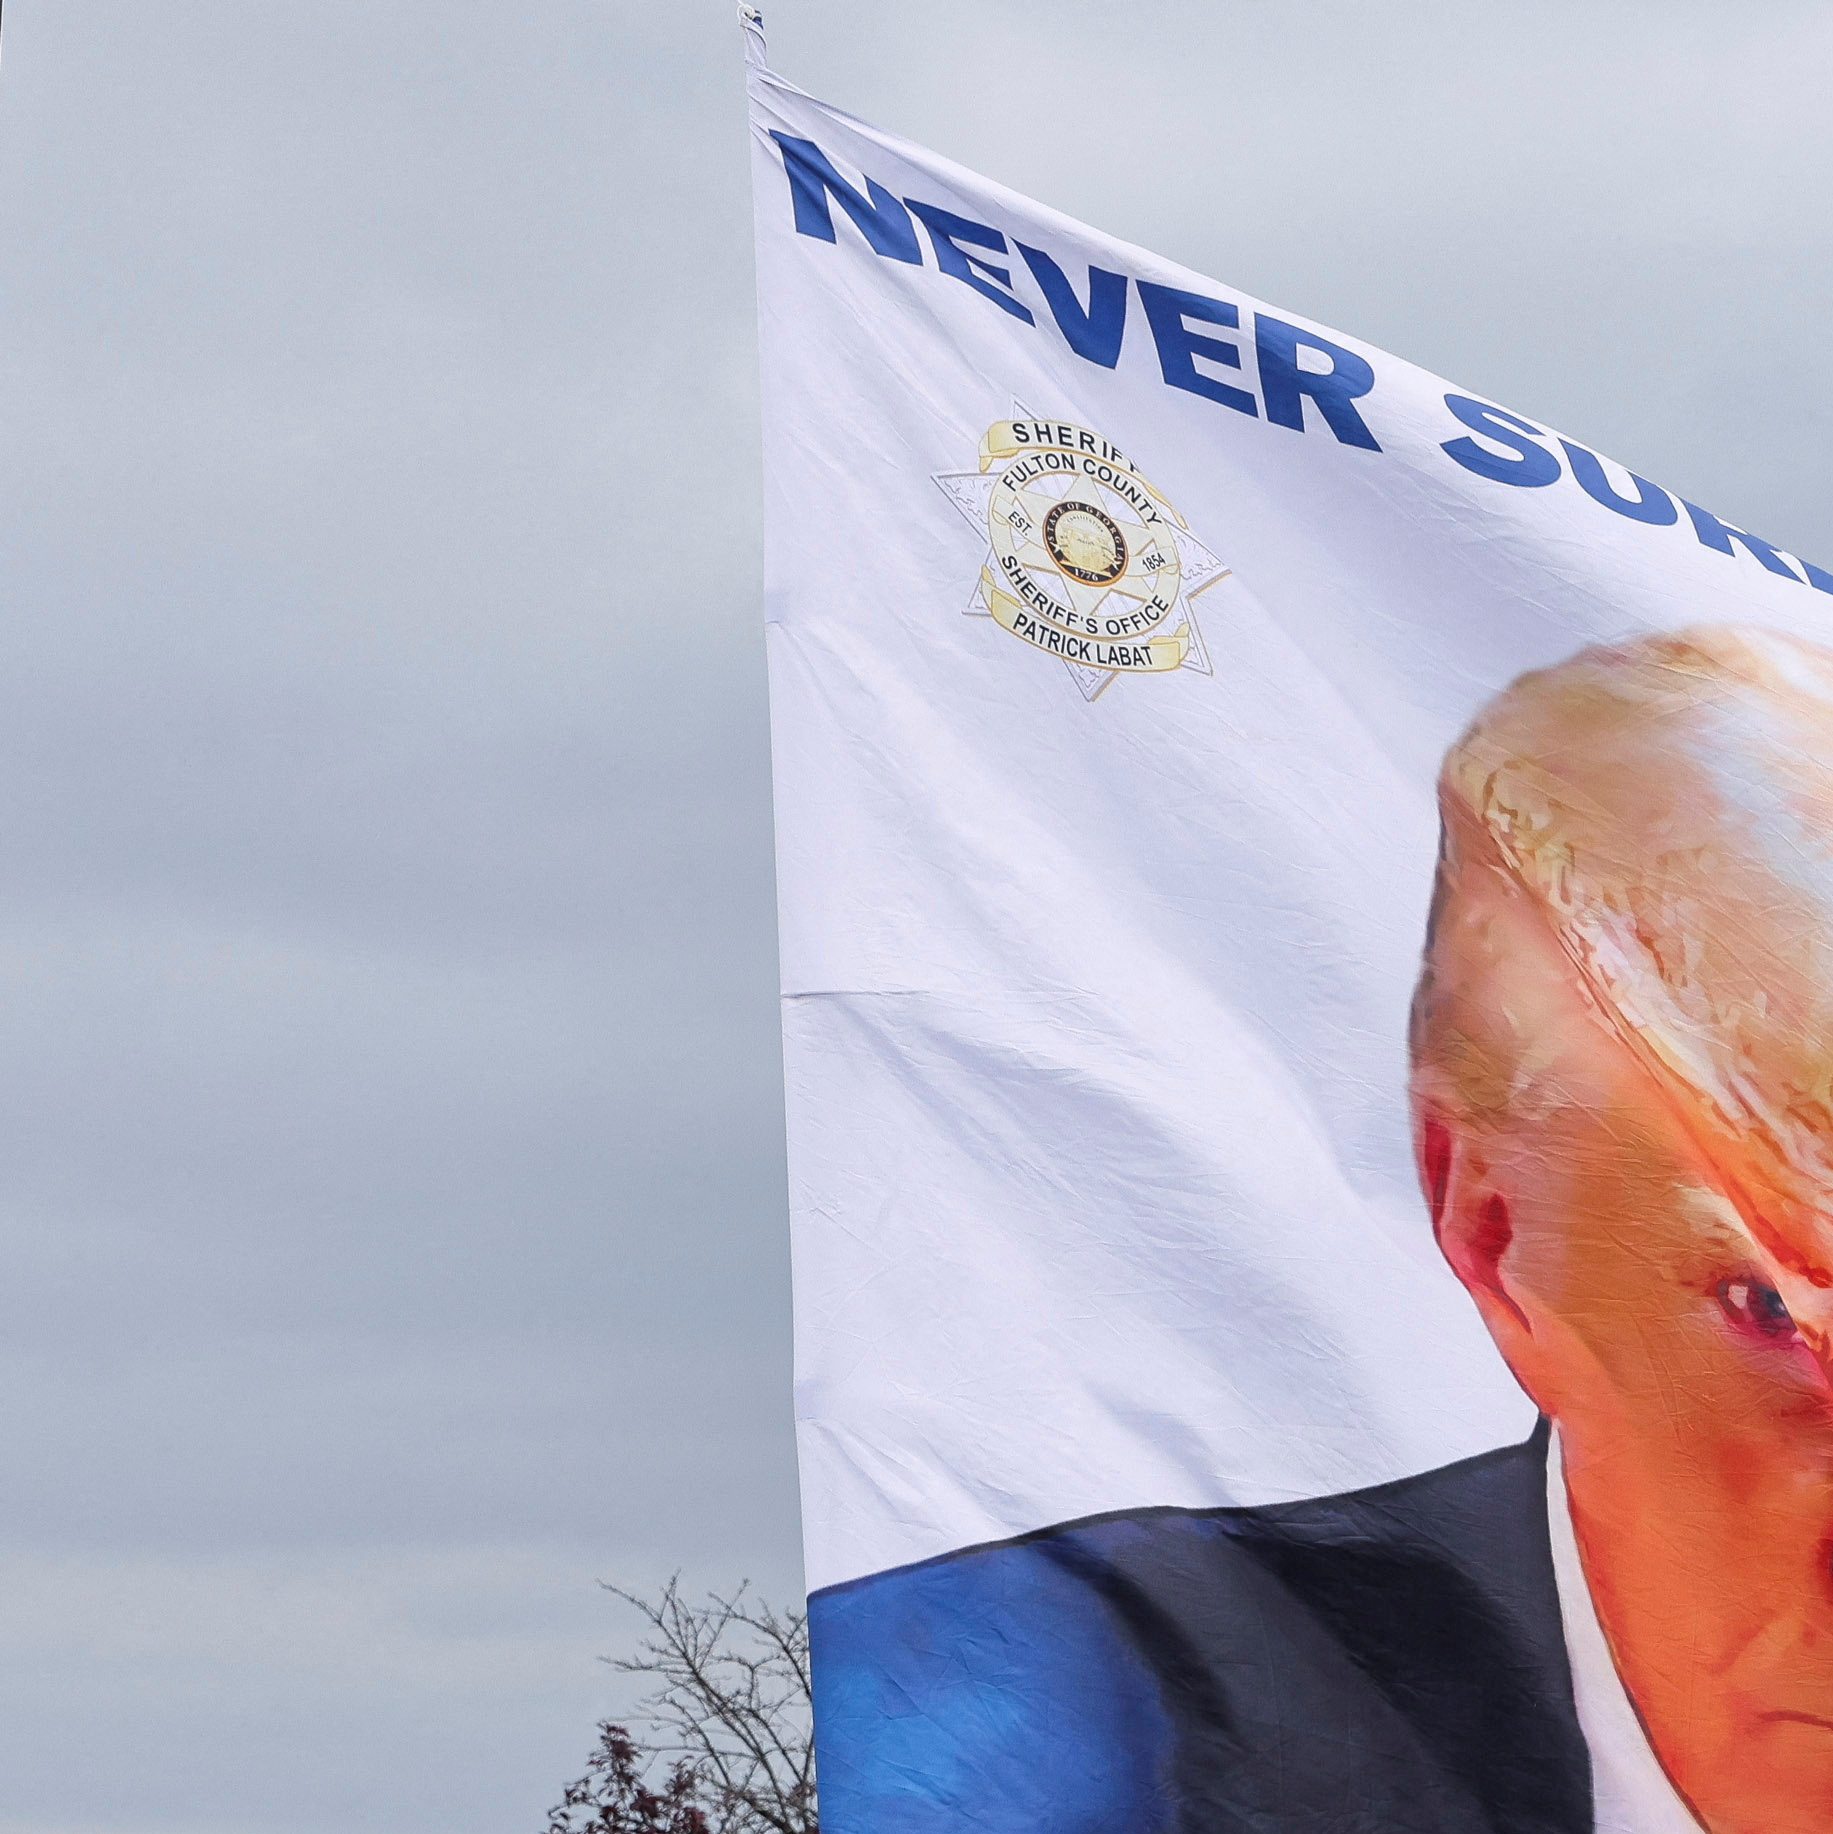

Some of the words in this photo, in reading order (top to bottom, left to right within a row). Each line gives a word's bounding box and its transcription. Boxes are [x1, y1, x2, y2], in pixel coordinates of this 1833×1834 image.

[768, 128, 1382, 453] NEVER
[1003, 452, 1075, 491] FULTON
[1083, 459, 1162, 526] COUNTY
[1008, 511, 1032, 537] EST.
[1047, 505, 1065, 541] STATE
[1067, 502, 1081, 511] OF
[1086, 505, 1124, 560] GEORGIA
[1075, 568, 1098, 581] 1776
[1142, 552, 1165, 572] 1854
[1002, 555, 1098, 635] SHERIFF'S
[1106, 594, 1170, 636] OFFICE
[1013, 612, 1091, 661] PATRICK
[1097, 645, 1154, 667] LABAT
